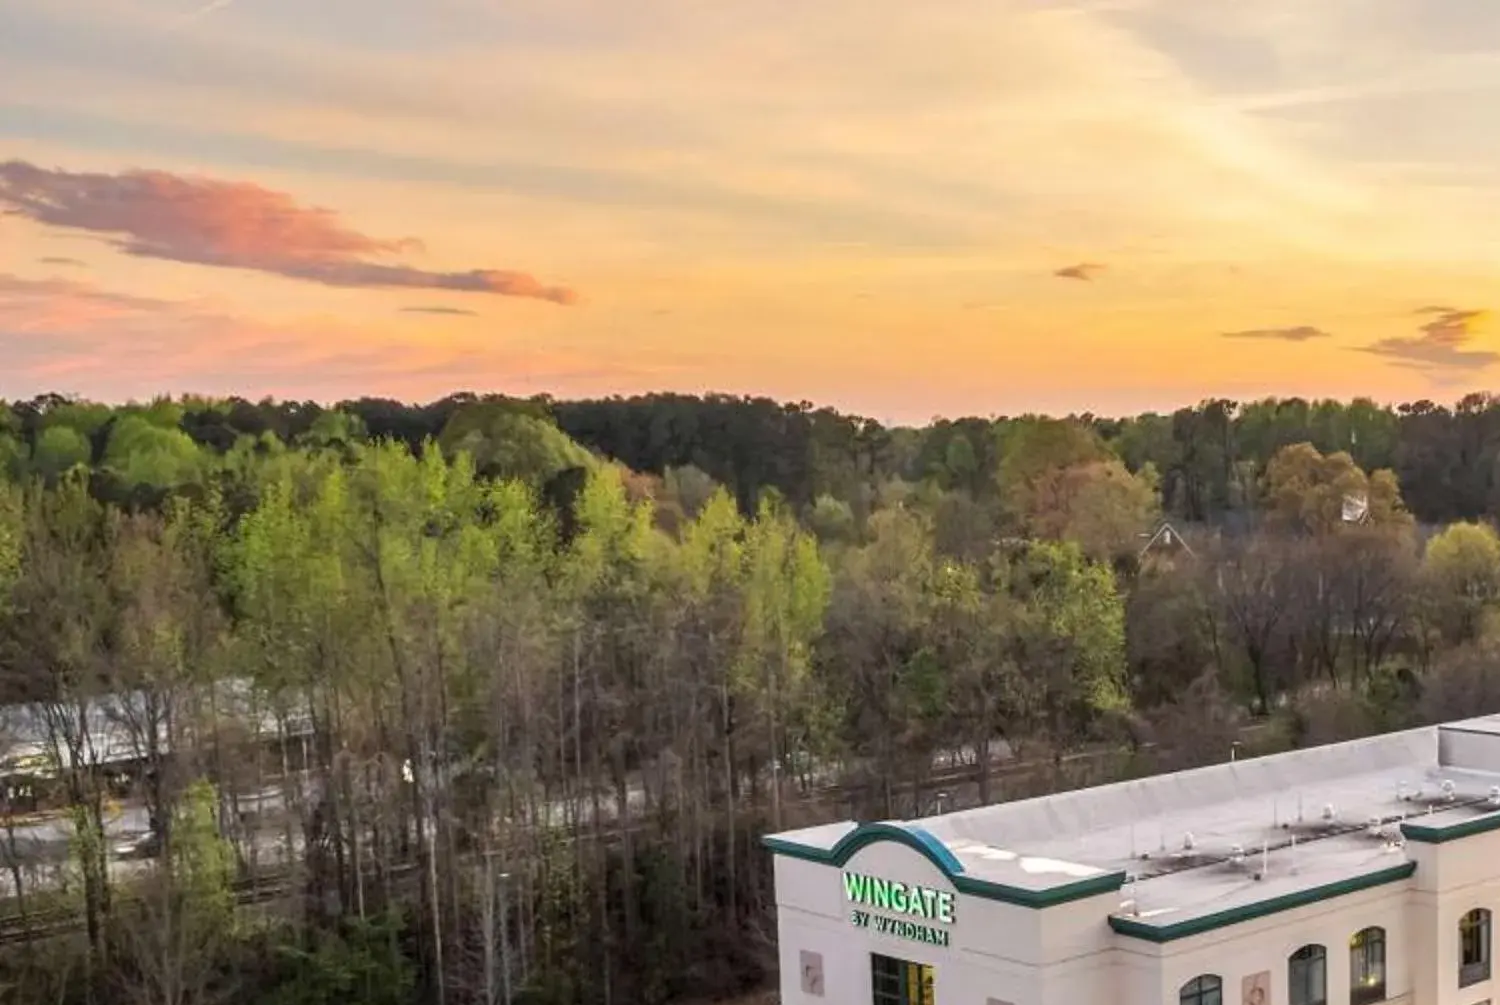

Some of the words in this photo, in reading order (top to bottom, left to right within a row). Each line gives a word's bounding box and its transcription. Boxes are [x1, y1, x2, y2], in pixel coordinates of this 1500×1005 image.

[843, 871, 956, 924] WINGATE
[850, 909, 870, 927] BY
[874, 915, 950, 947] WYNDHAM
